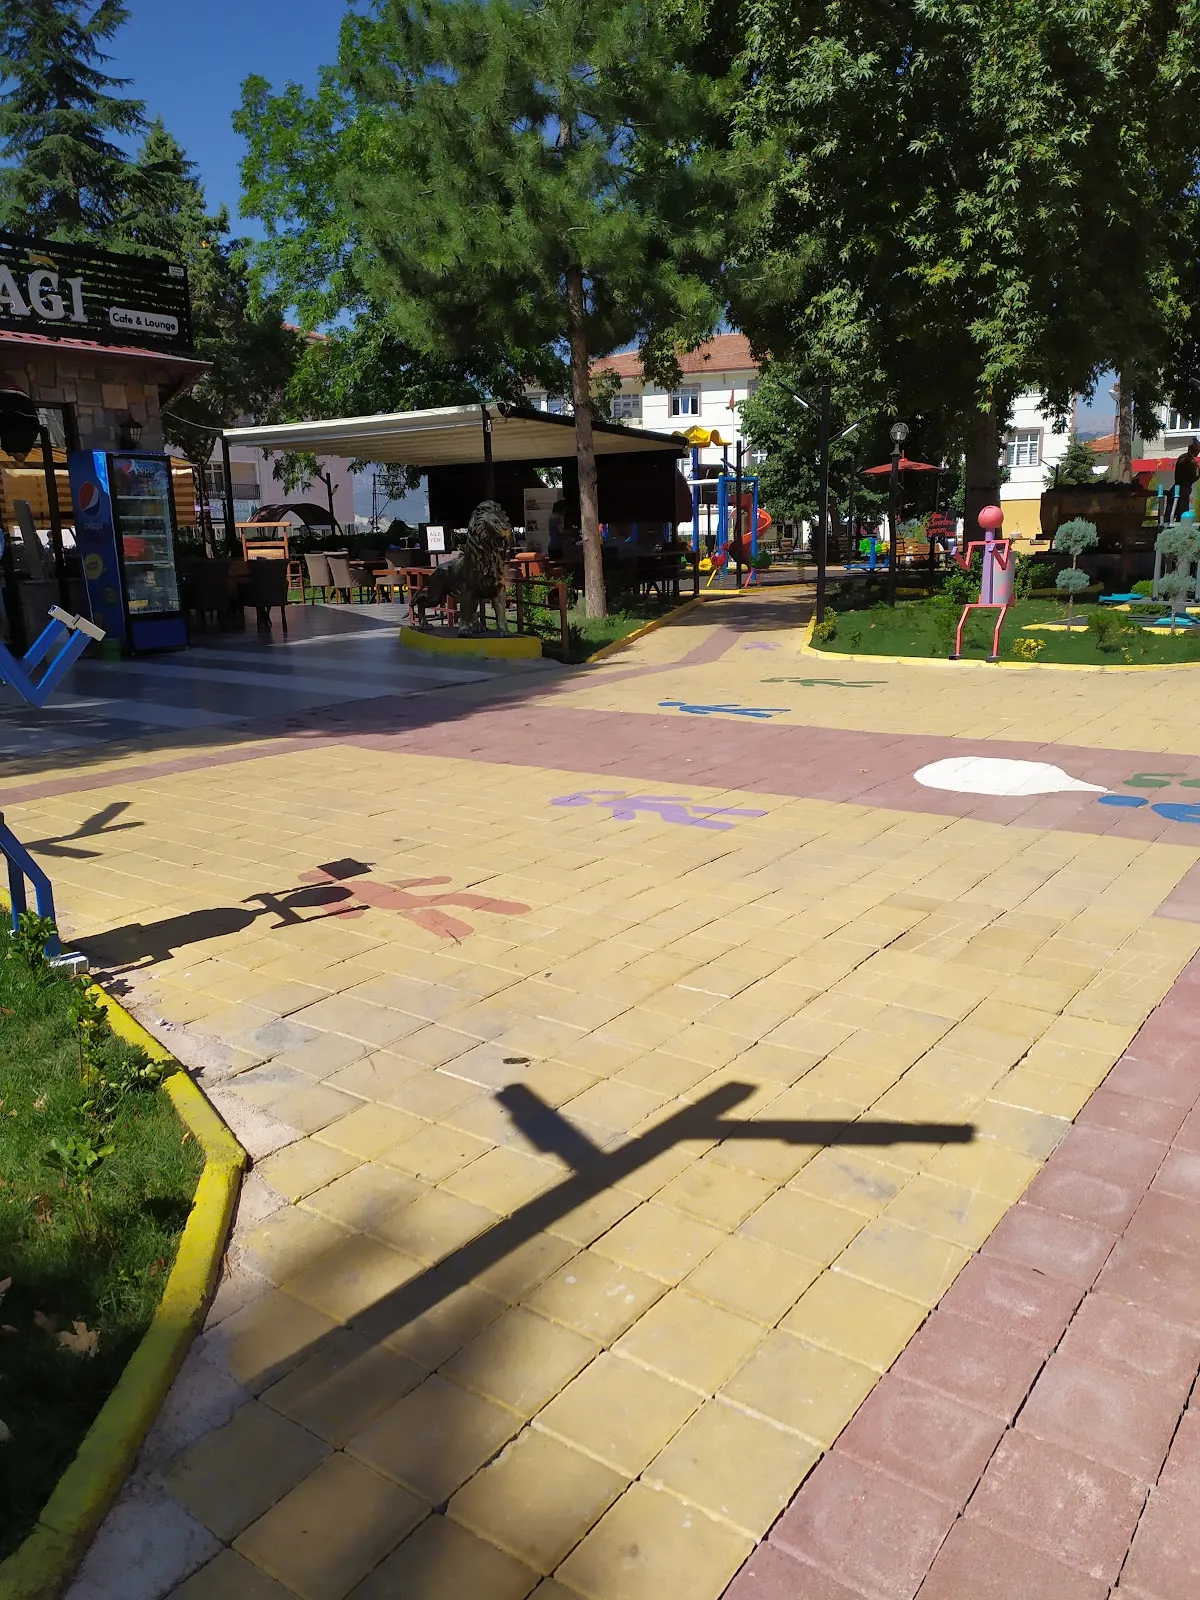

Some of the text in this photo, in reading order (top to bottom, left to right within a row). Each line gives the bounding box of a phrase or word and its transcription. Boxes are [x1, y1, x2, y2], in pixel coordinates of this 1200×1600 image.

[112, 312, 176, 332] Cafe & Lounge
